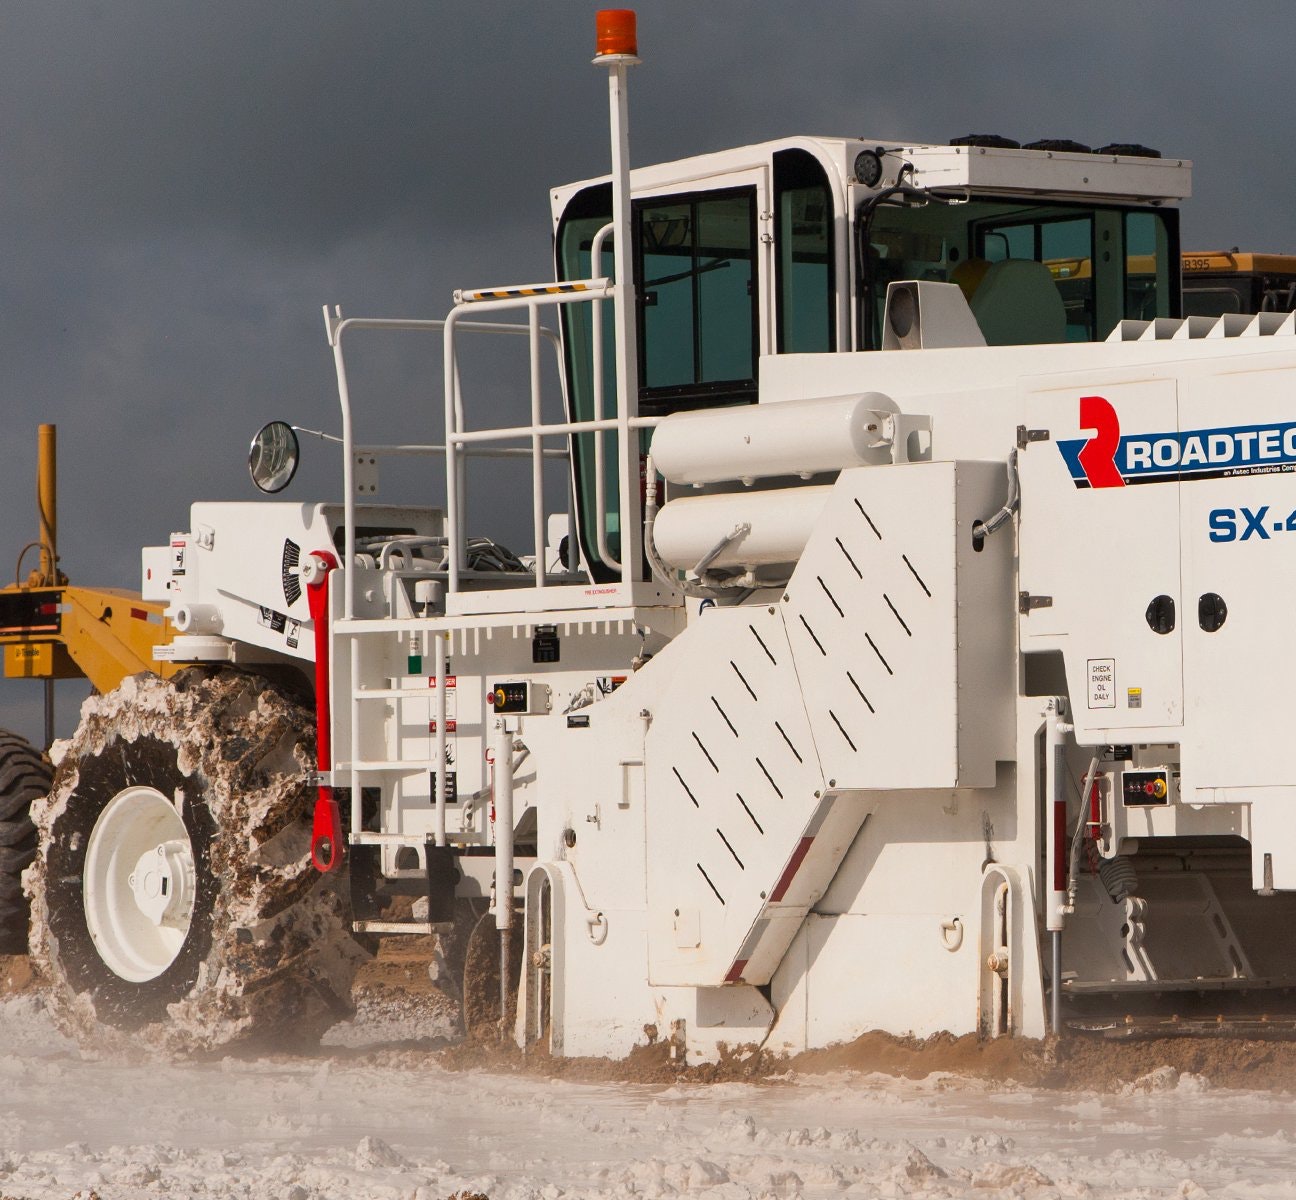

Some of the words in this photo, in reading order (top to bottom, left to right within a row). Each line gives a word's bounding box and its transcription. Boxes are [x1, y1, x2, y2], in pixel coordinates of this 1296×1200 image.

[1251, 465, 1280, 474] Industries
[1092, 665, 1111, 673] CHECK
[1091, 674, 1112, 682] ENGINE
[1094, 693, 1110, 701] DAILY
